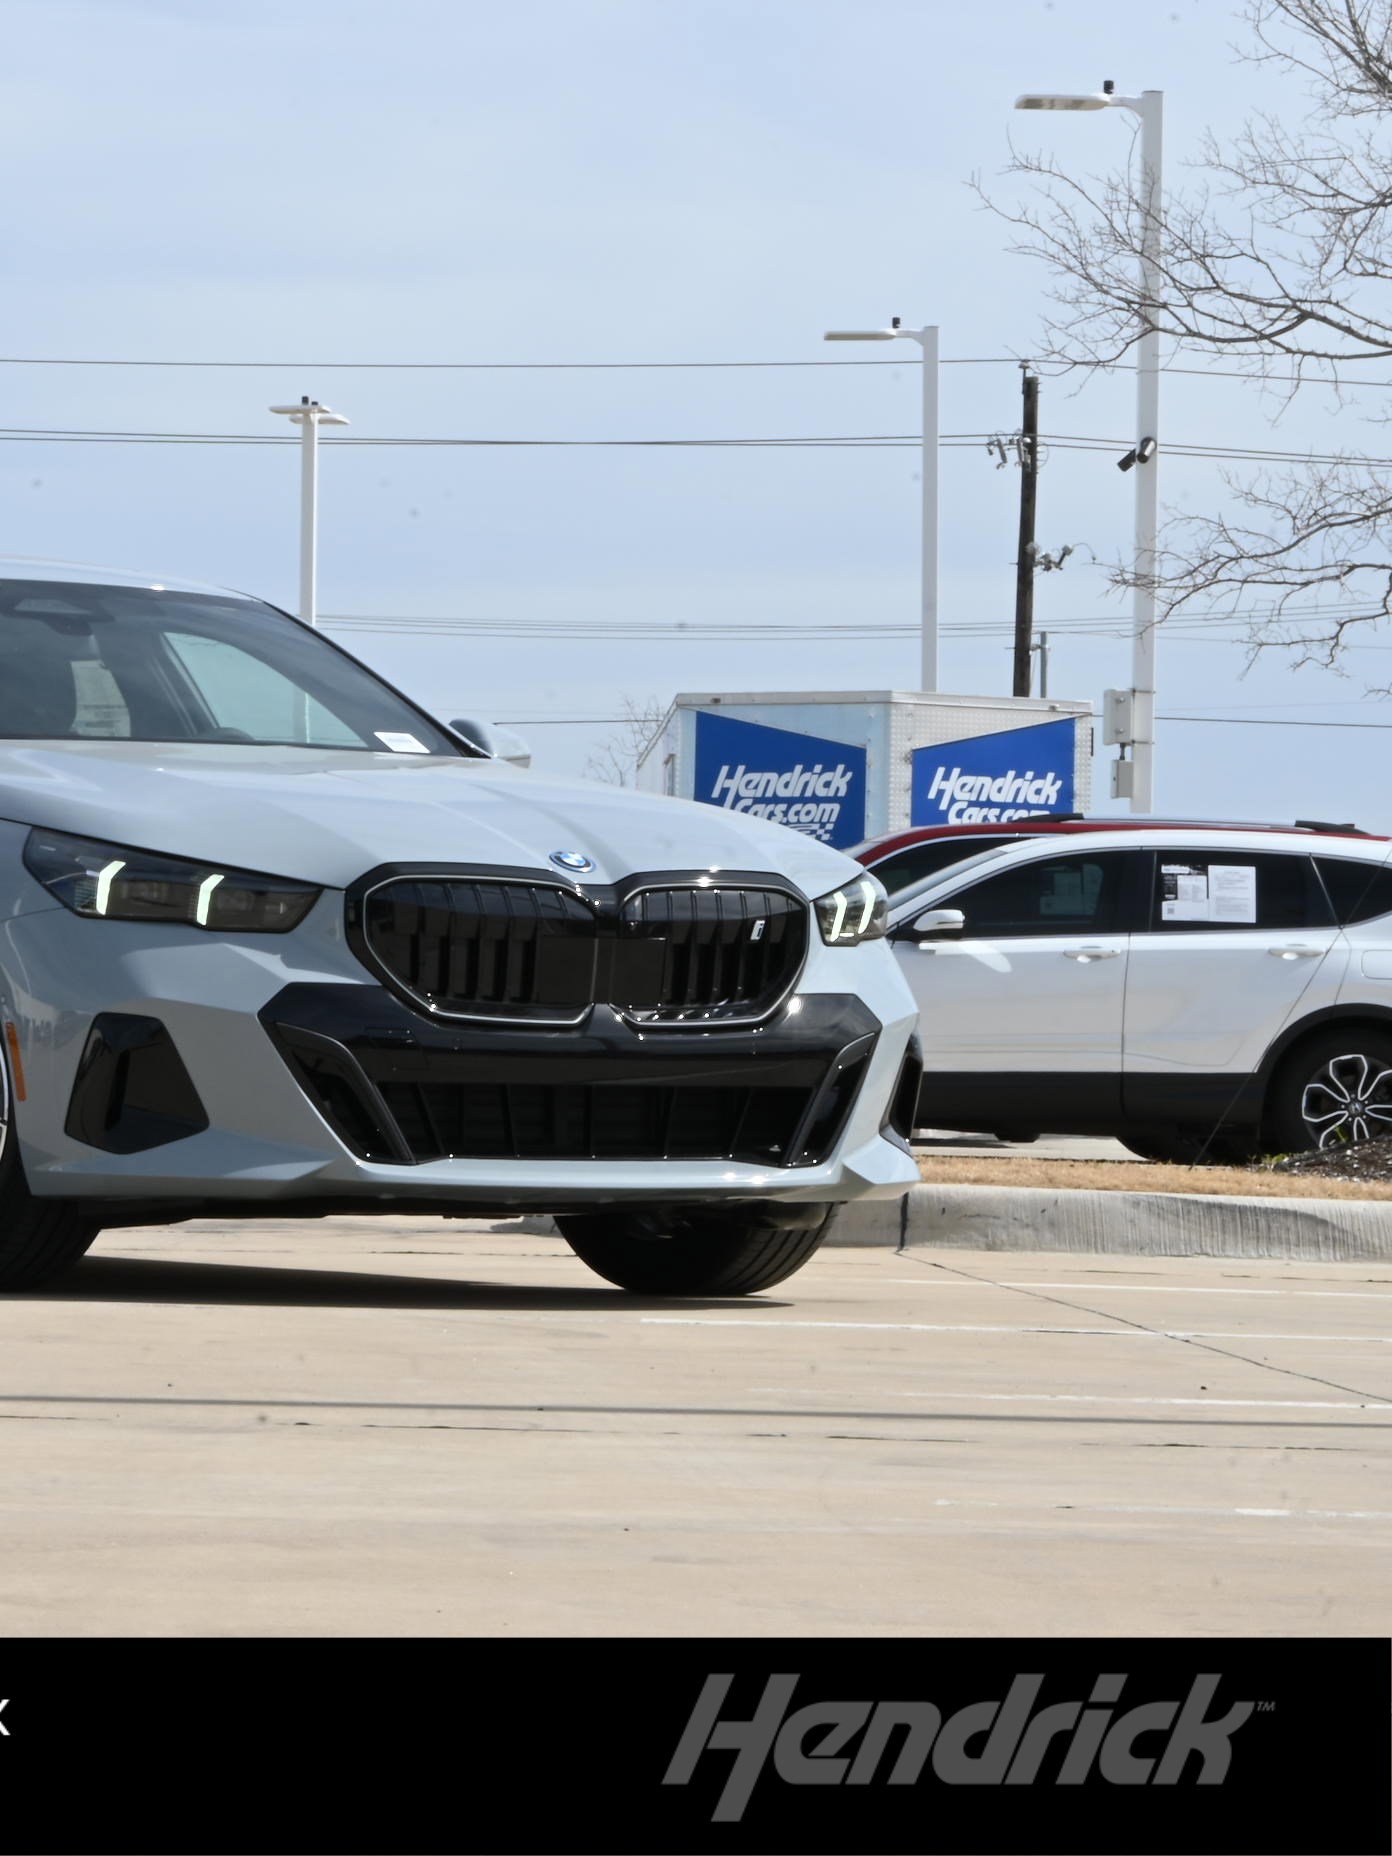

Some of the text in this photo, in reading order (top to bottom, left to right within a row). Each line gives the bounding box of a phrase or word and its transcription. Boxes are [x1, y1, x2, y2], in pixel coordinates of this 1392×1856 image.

[711, 764, 853, 810] Hendrick
[928, 767, 1063, 810] Hendrick
[948, 801, 1051, 825] Carsc
